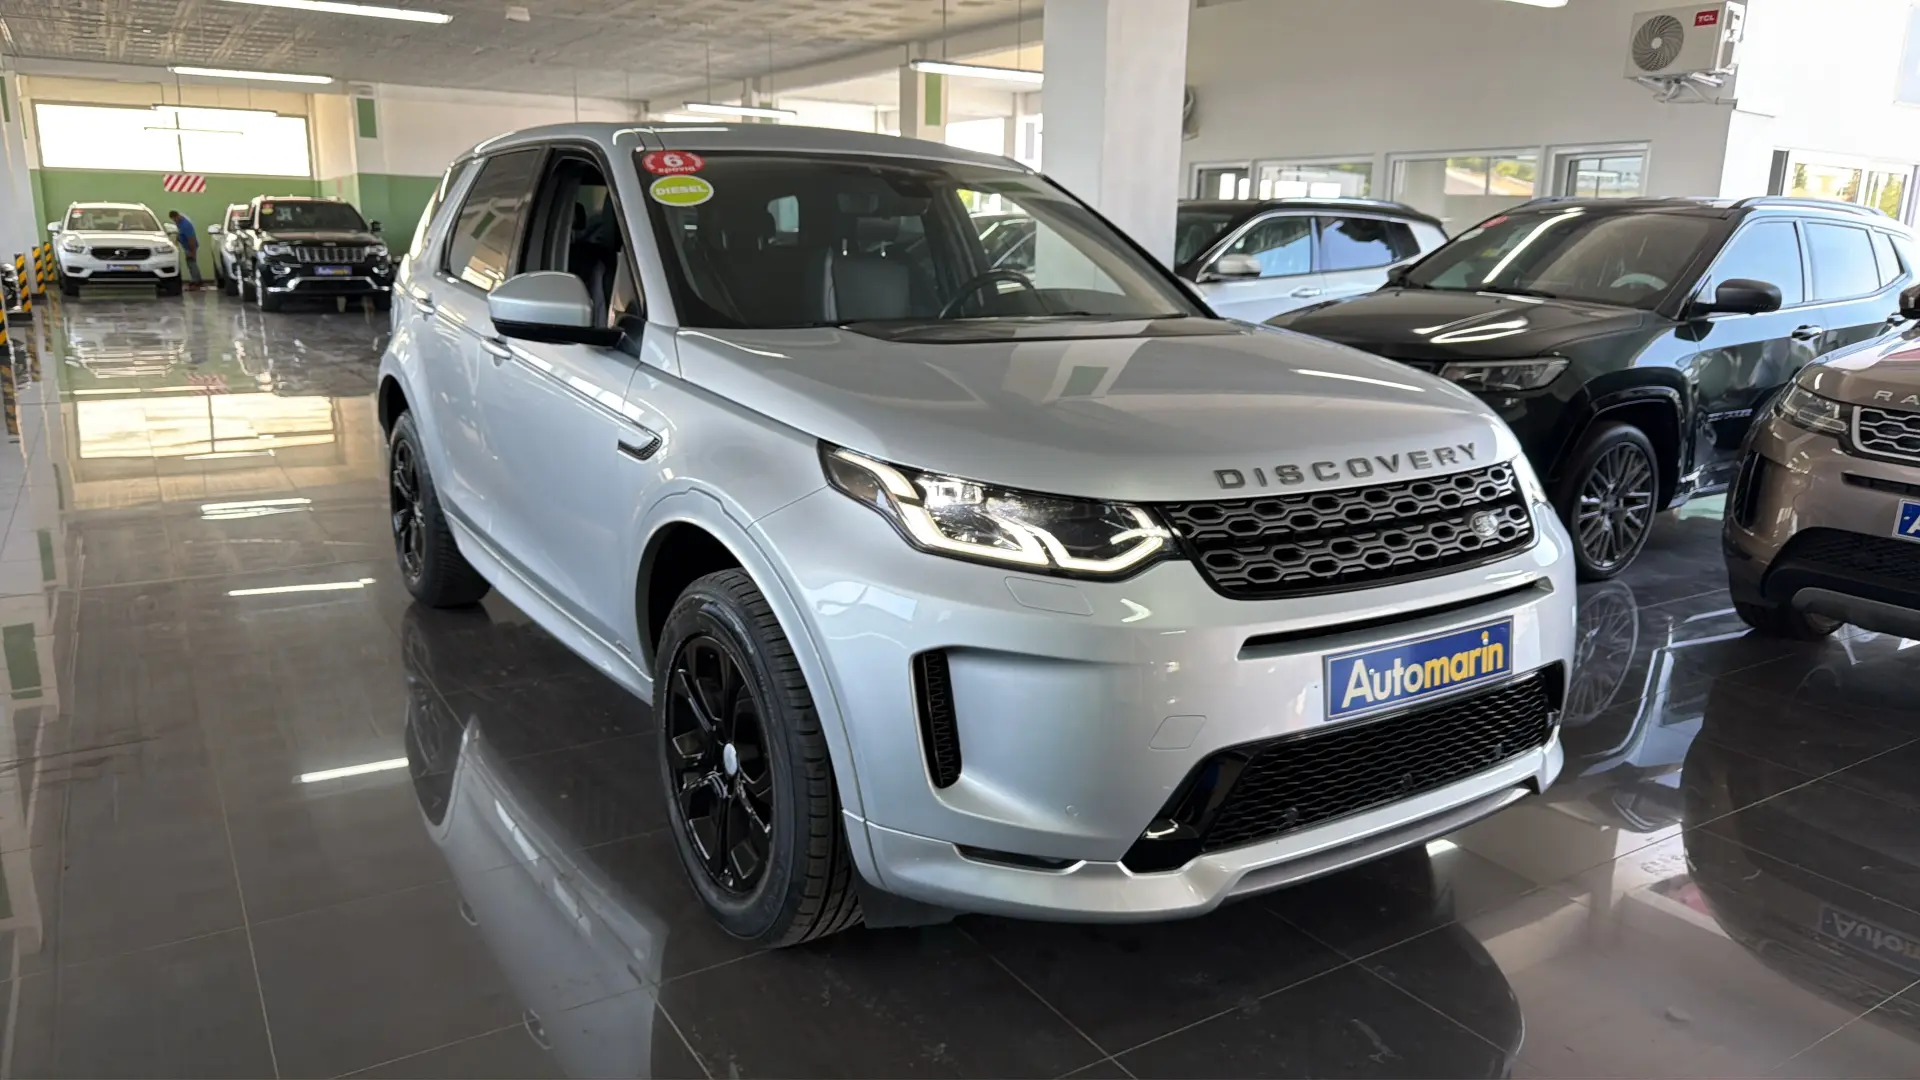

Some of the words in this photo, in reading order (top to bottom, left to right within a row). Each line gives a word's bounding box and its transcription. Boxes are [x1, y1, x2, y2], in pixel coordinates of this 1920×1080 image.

[1698, 14, 1715, 22] TCL
[663, 153, 684, 168] 6
[655, 185, 709, 196] DIESEL
[1213, 442, 1476, 490] DISCOVERY
[1341, 630, 1504, 709] Automarin
